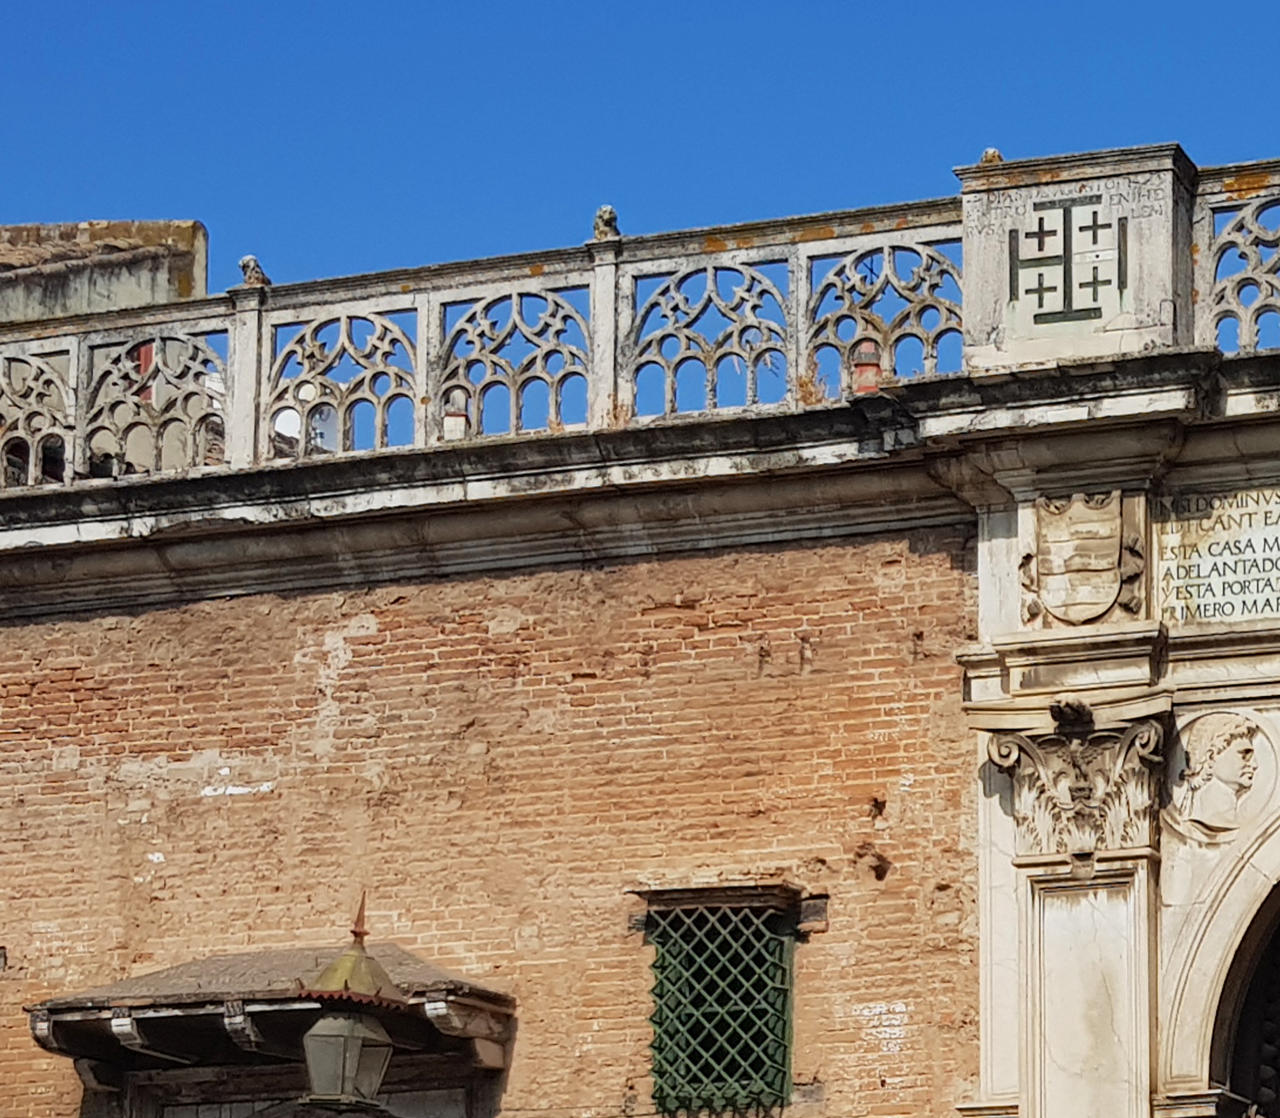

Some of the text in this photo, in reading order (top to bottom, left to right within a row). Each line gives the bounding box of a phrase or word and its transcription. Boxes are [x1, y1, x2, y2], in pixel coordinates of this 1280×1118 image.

[1159, 543, 1201, 561] ESTA
[1207, 537, 1256, 557] CASA
[1160, 602, 1235, 622] PRIMERO
